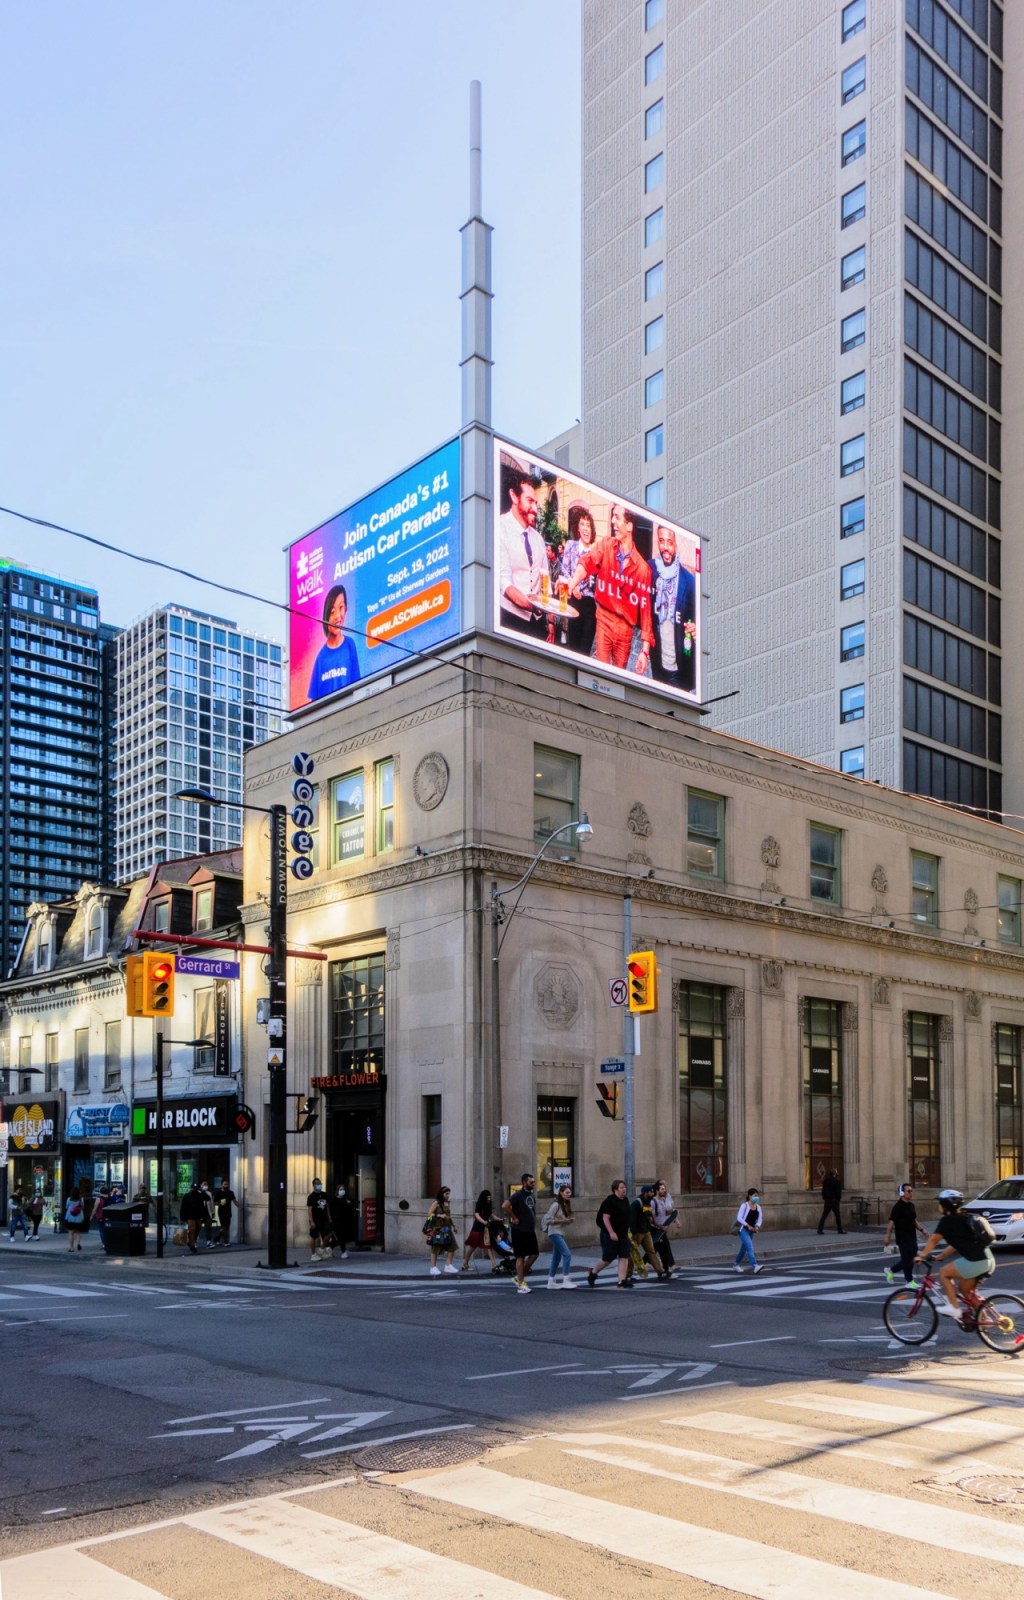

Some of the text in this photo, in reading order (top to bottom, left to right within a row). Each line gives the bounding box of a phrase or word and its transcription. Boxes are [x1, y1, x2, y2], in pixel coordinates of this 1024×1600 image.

[343, 470, 449, 549] Join Canada's #1
[334, 501, 450, 580] Autism Car Parade
[387, 544, 449, 587] Sept. 19, 2021
[611, 570, 634, 586] TASTE
[297, 569, 323, 597] walk
[589, 575, 622, 600] FULL
[629, 592, 647, 609] OF
[370, 594, 444, 638] www.ASCWalk.ca
[279, 814, 287, 904] DOWNTOWN
[342, 837, 364, 853] TATTOO
[178, 957, 222, 974] Gerrard
[175, 1107, 216, 1128] BLOCK
